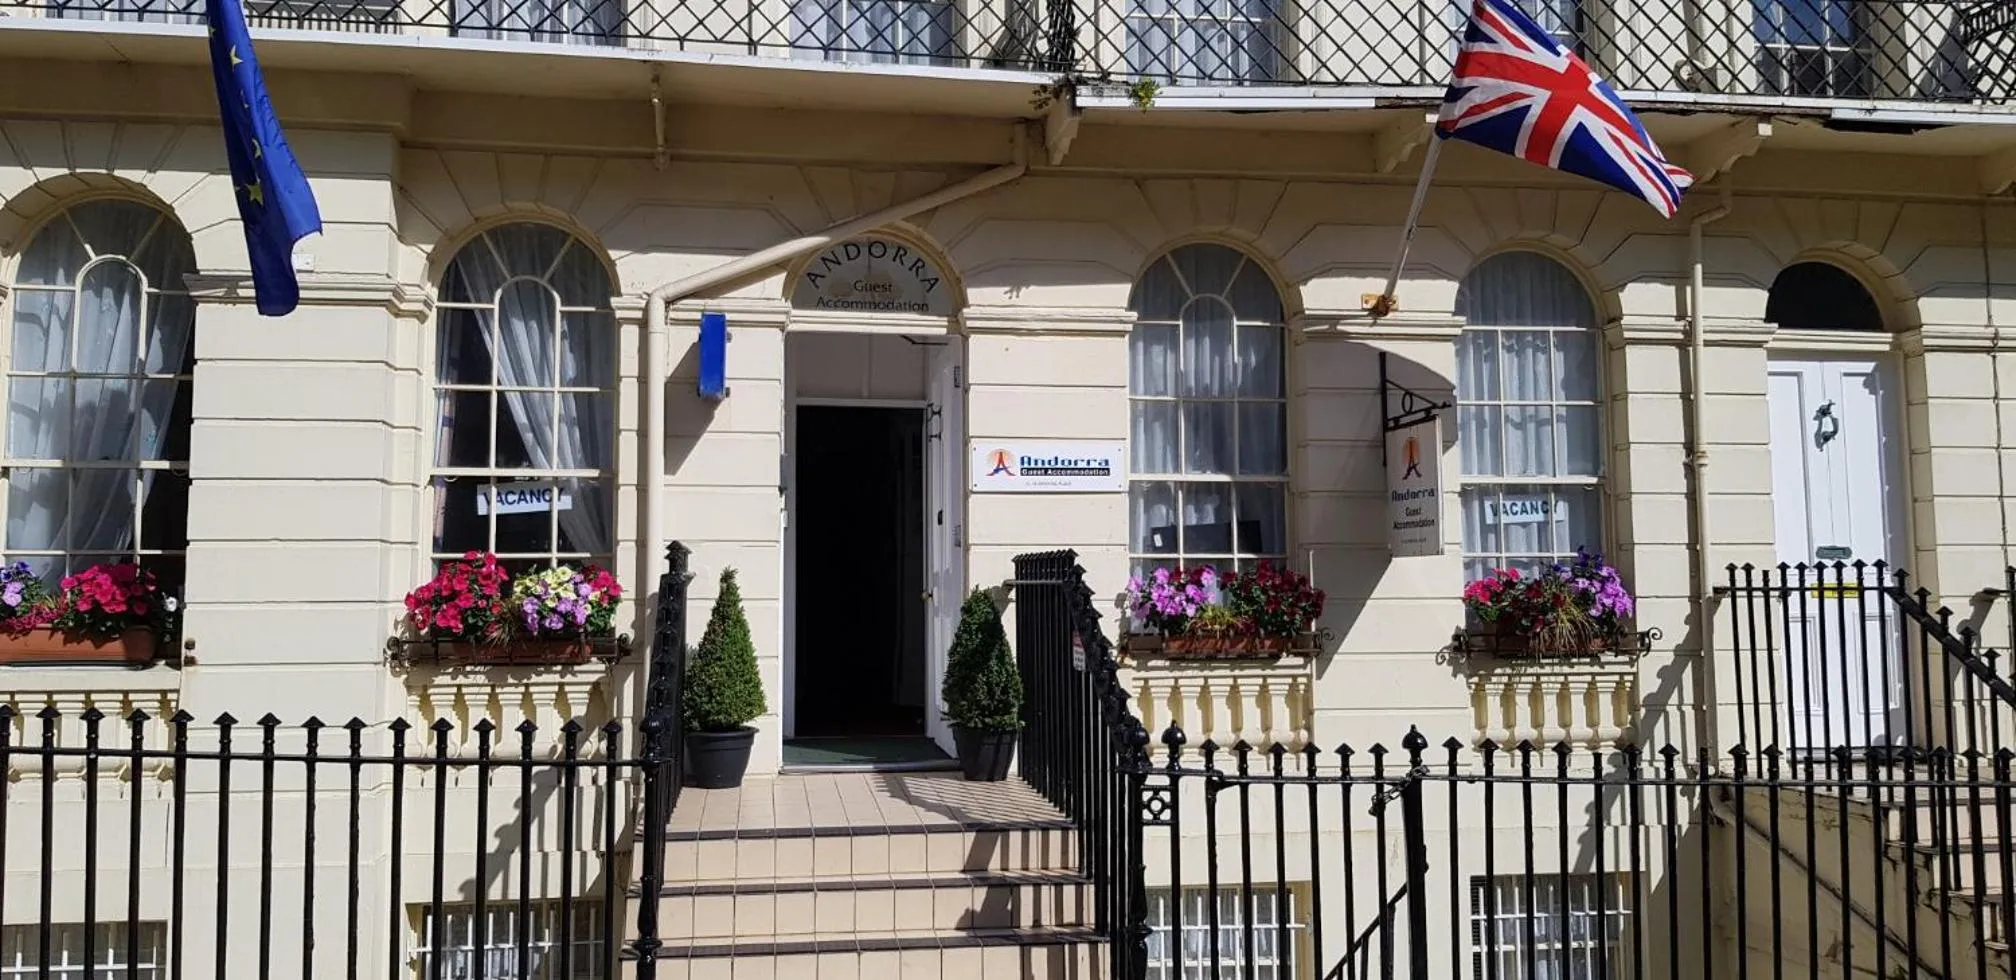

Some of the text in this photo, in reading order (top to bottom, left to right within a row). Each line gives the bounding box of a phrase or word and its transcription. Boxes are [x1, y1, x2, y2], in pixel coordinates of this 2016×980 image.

[806, 241, 940, 294] ANDORRA
[853, 280, 893, 293] Guest
[816, 297, 929, 312] Accommodation
[1020, 456, 1109, 466] Andorra
[1391, 488, 1435, 502] Andorra
